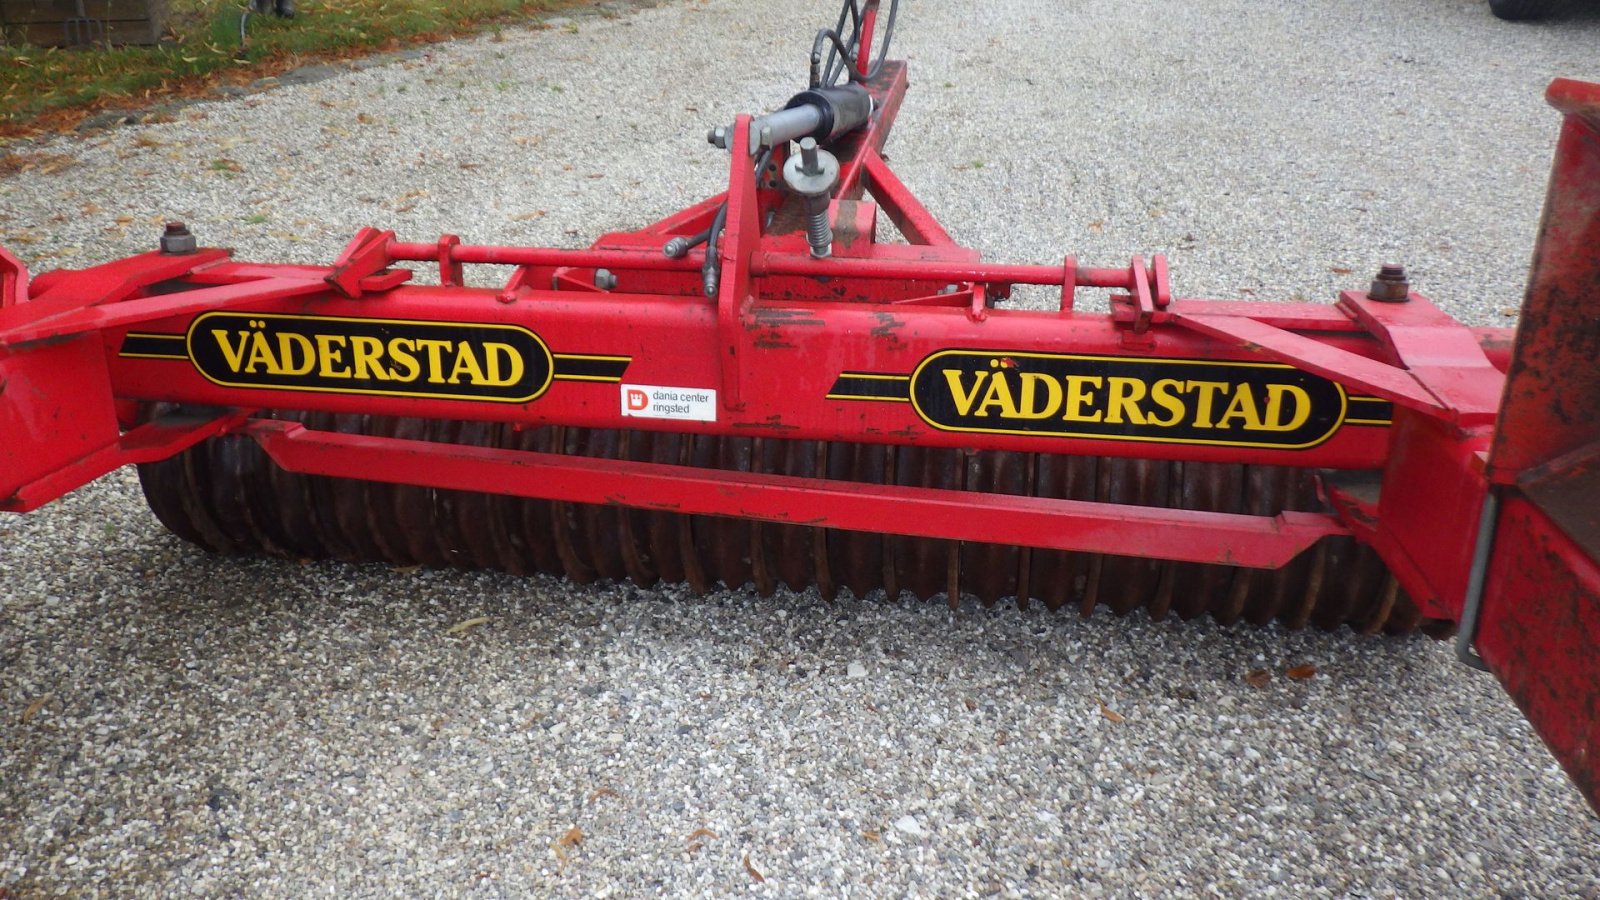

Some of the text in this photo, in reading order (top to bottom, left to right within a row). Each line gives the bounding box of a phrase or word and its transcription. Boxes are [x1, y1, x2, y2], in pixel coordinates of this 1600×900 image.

[211, 320, 525, 387] VÄDERSTAD
[652, 390, 709, 403] dania center
[652, 402, 690, 414] ringsted
[942, 358, 1311, 432] VÄDERSTAD
